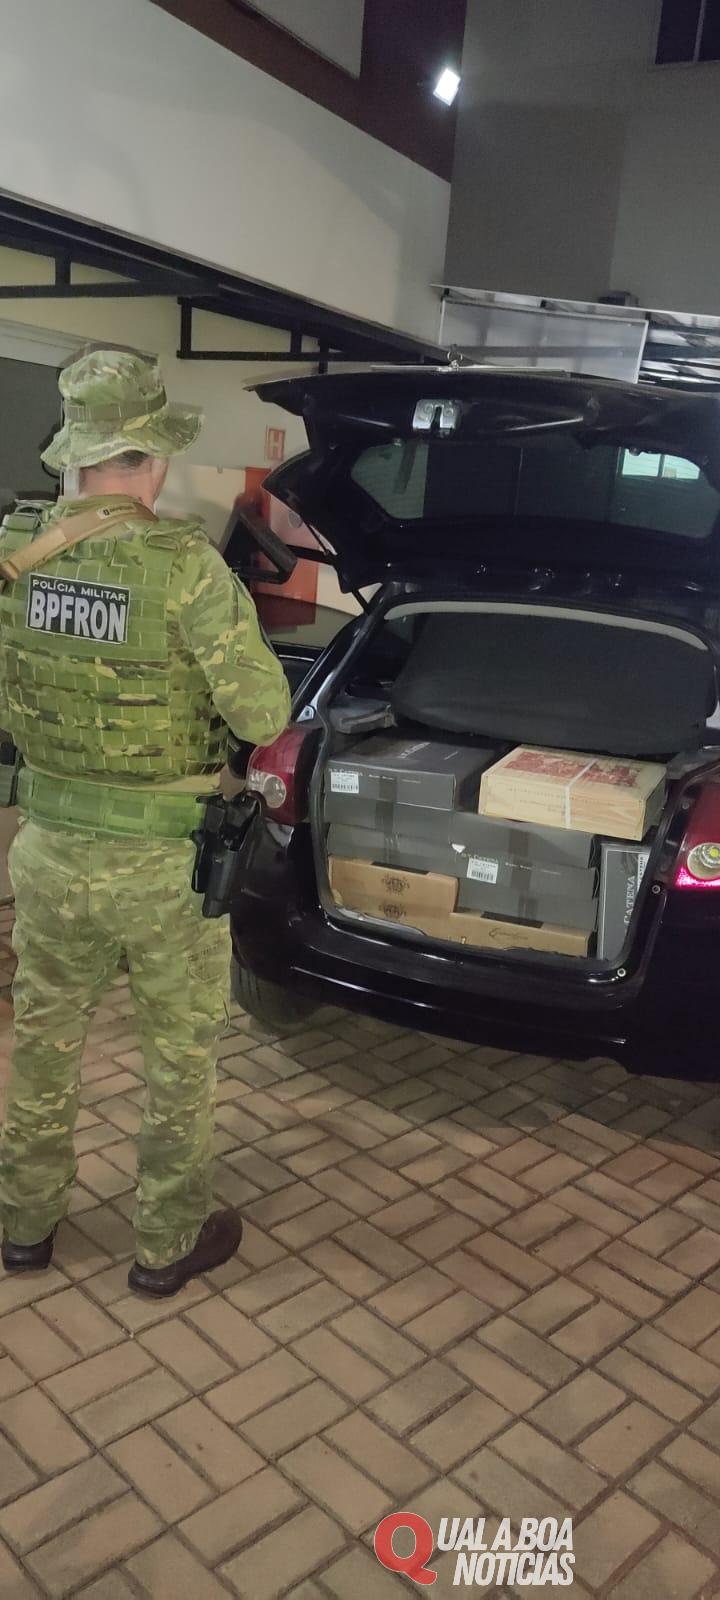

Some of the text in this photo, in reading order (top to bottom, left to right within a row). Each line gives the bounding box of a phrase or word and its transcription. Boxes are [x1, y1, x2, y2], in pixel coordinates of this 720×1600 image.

[33, 579, 127, 602] POLÍCIA MILITAR
[29, 590, 127, 641] BPFRON
